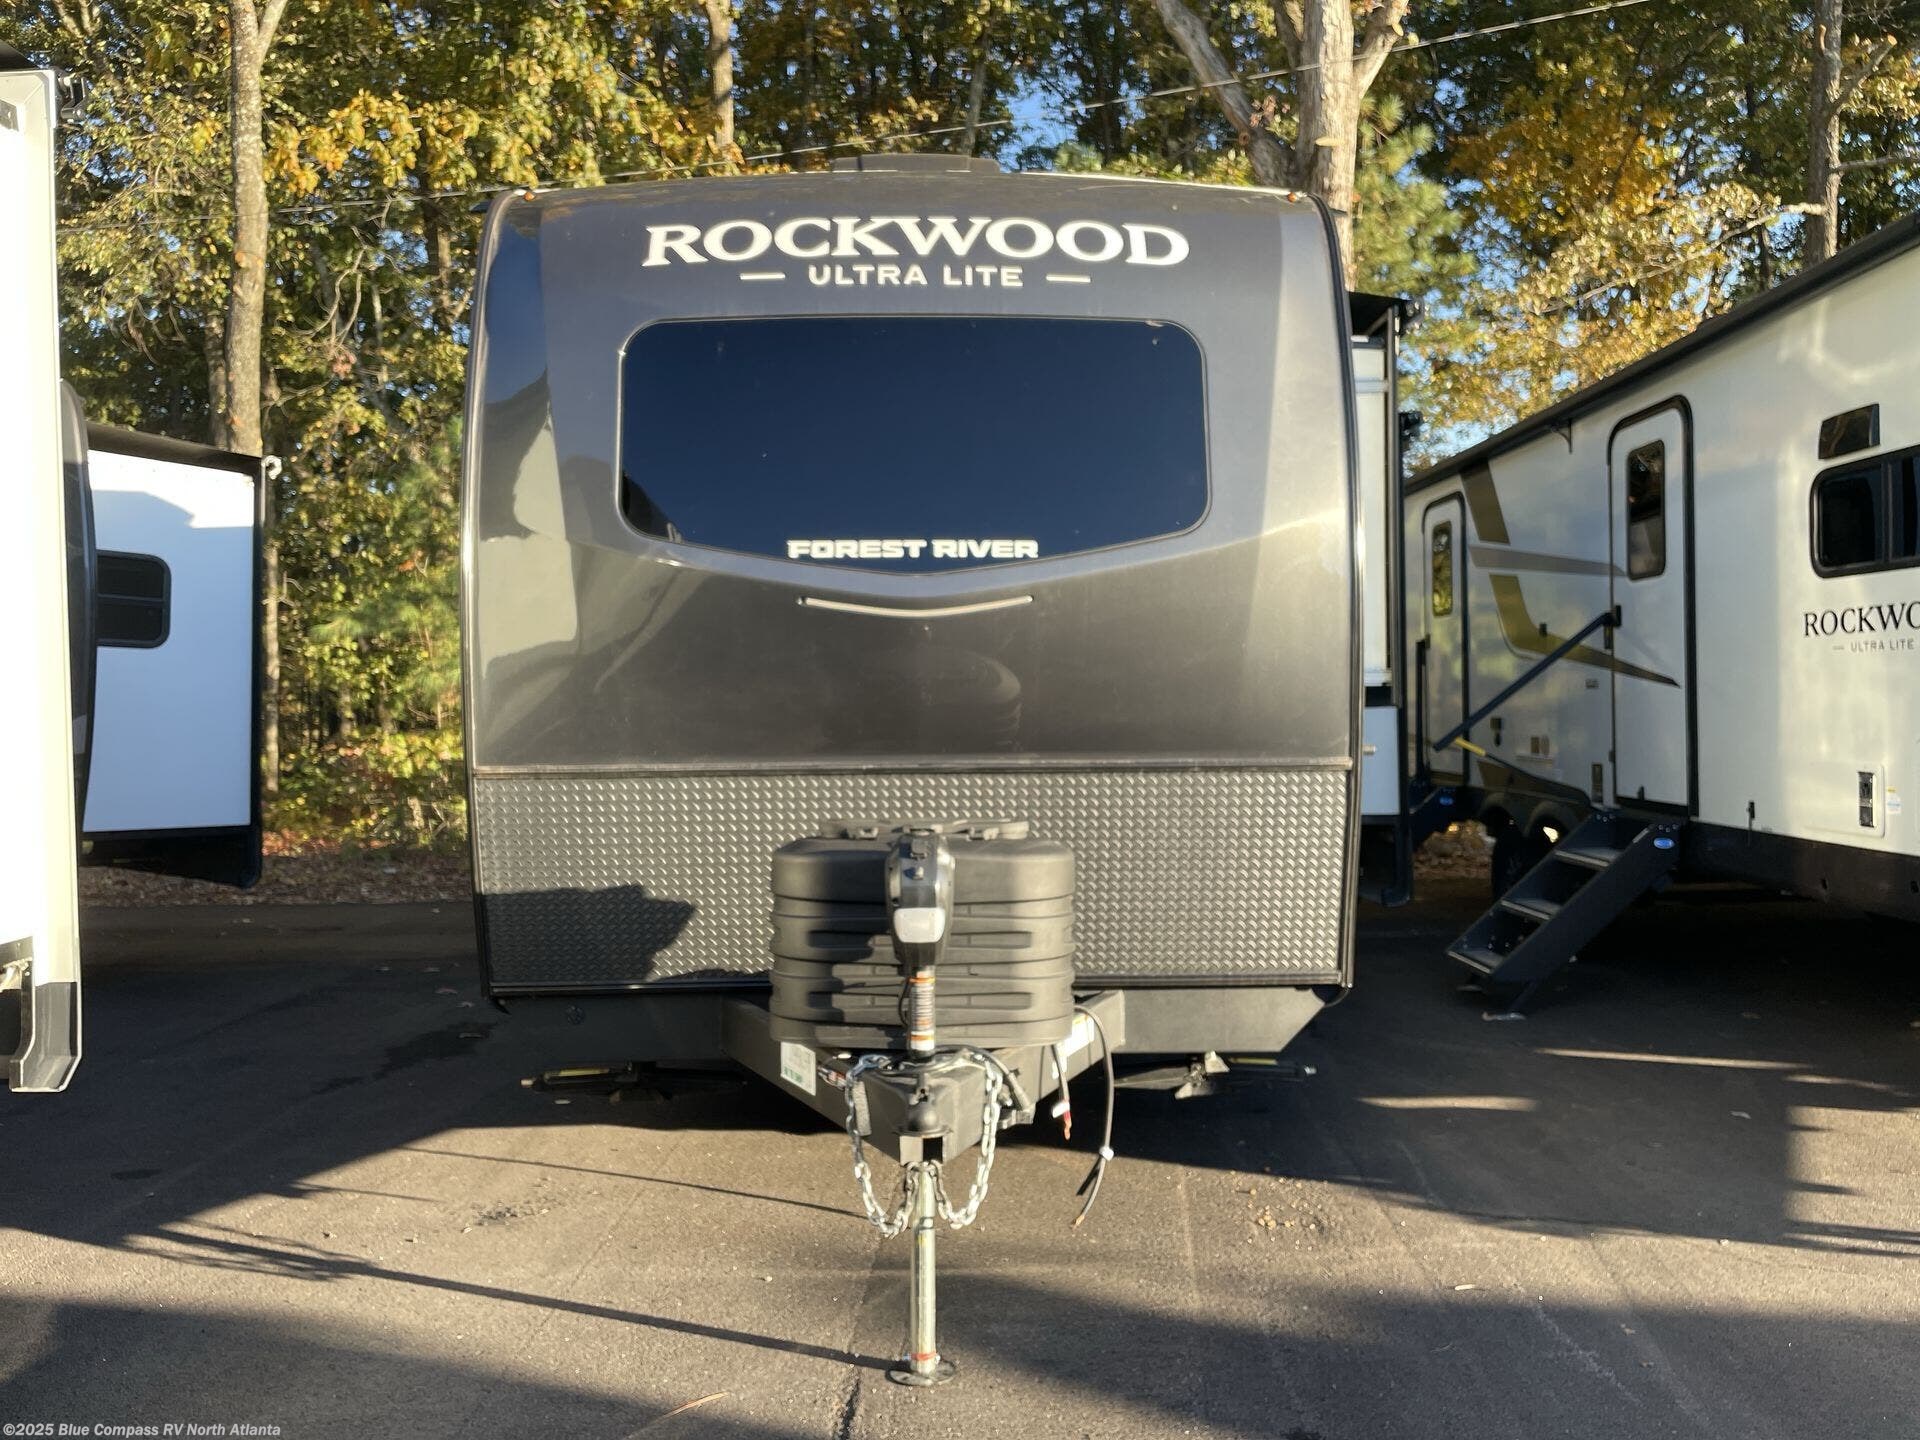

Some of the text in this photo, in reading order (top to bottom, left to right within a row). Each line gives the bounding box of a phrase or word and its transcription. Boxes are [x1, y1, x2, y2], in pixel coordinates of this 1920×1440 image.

[642, 216, 1190, 267] ROCKWOOD
[808, 265, 1023, 287] ULTRA LITE
[786, 539, 1039, 559] FOREST RIVER
[1804, 601, 1920, 637] ROCKWO
[1850, 638, 1914, 653] ULTRA LITE
